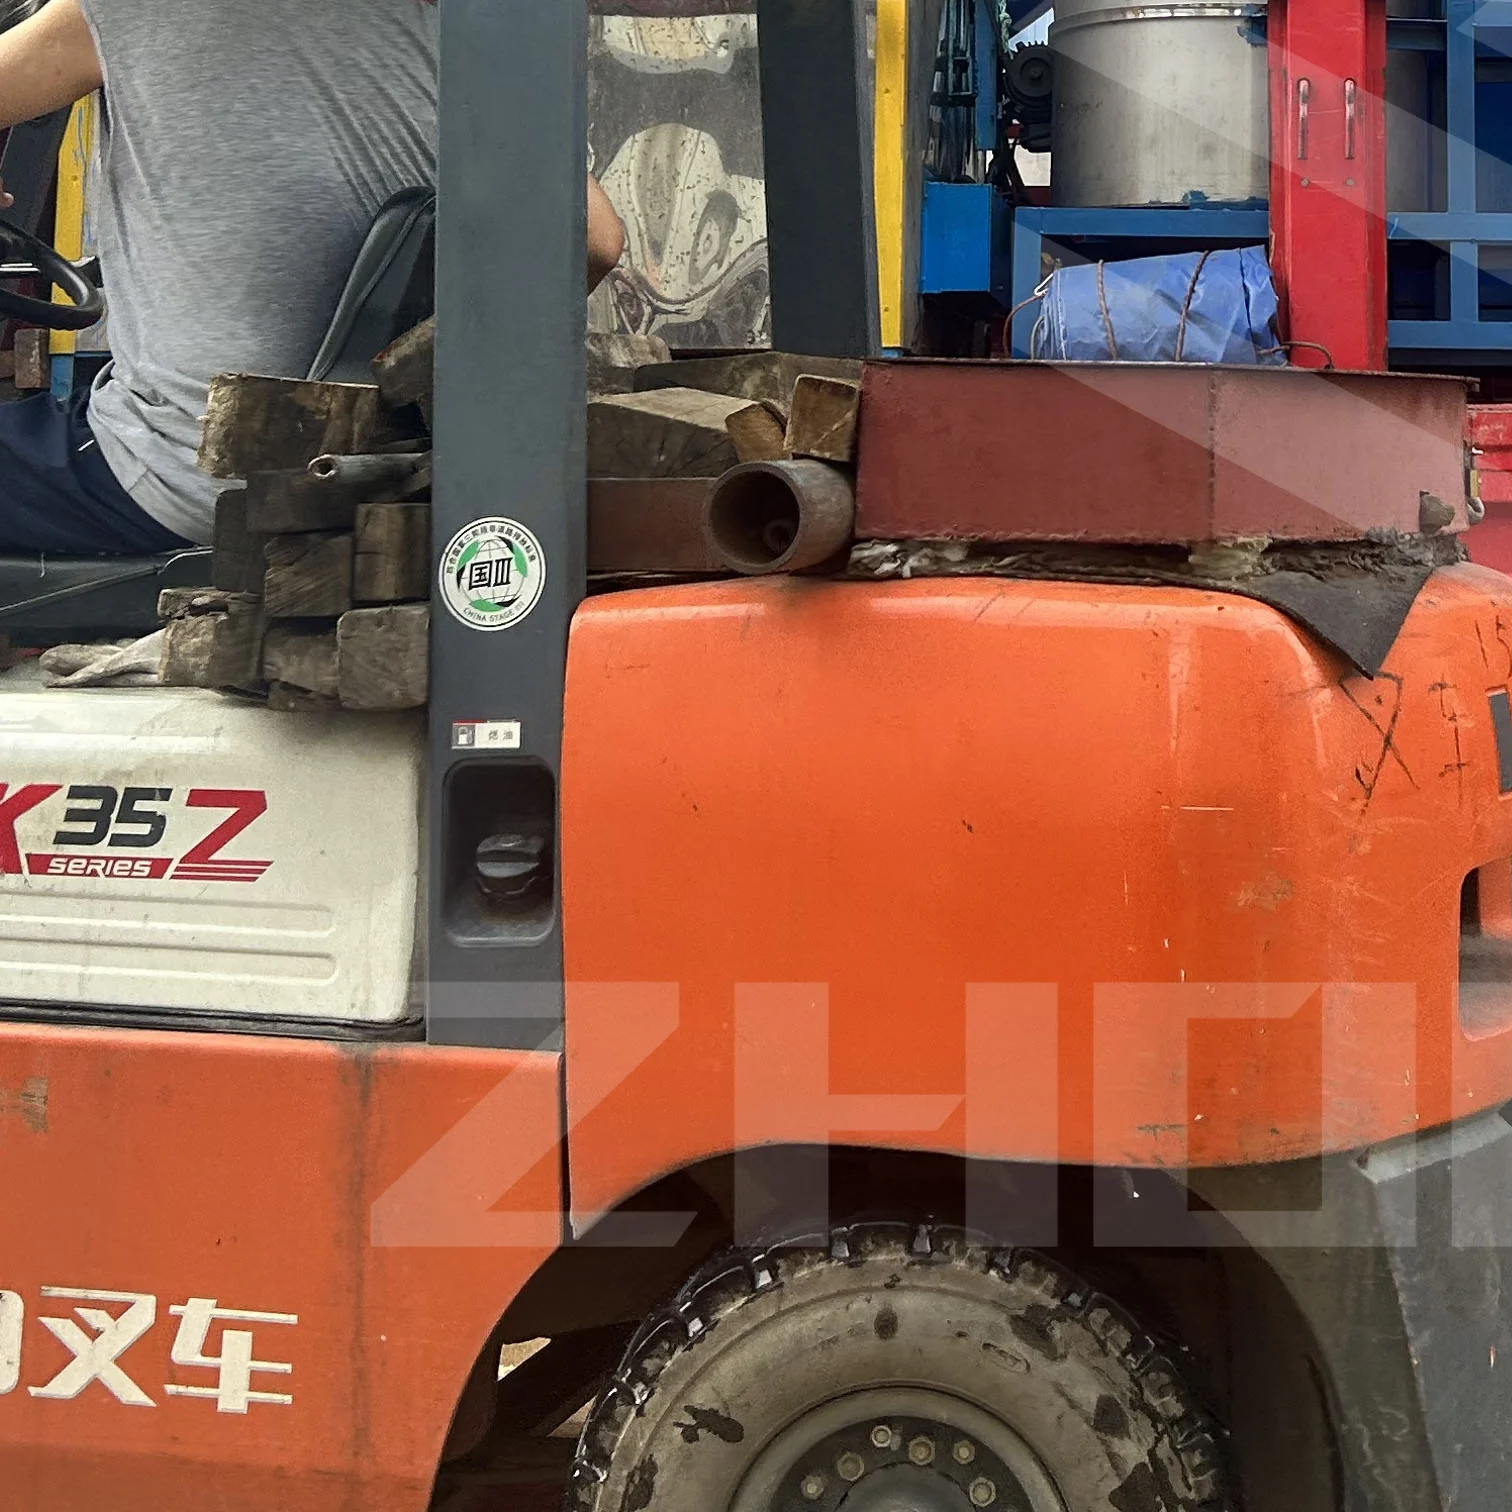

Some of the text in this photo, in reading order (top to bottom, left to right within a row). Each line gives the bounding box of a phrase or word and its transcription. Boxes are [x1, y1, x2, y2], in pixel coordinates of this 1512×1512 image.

[463, 607, 487, 622] CHINA
[489, 609, 515, 622] STAGE
[0, 1285, 298, 1415] 叉车
